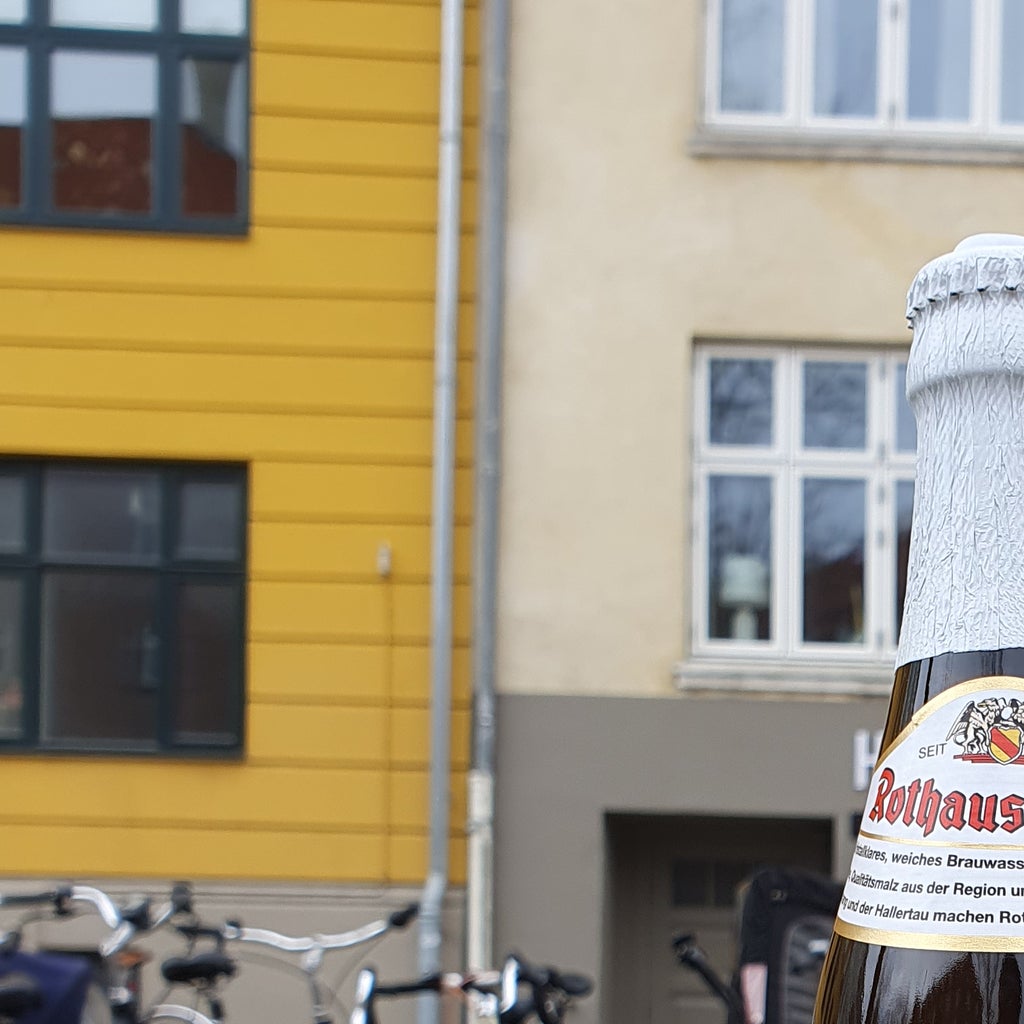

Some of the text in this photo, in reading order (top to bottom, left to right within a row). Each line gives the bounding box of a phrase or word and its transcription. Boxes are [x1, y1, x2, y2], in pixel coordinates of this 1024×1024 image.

[918, 743, 948, 759] SEIT
[892, 852, 942, 867] weiches
[901, 881, 924, 894] aus
[926, 881, 950, 895] der
[953, 882, 1006, 898] Region
[847, 900, 860, 912] und
[859, 901, 874, 916] der
[874, 903, 930, 921] Hallertau
[933, 909, 995, 923] machen
